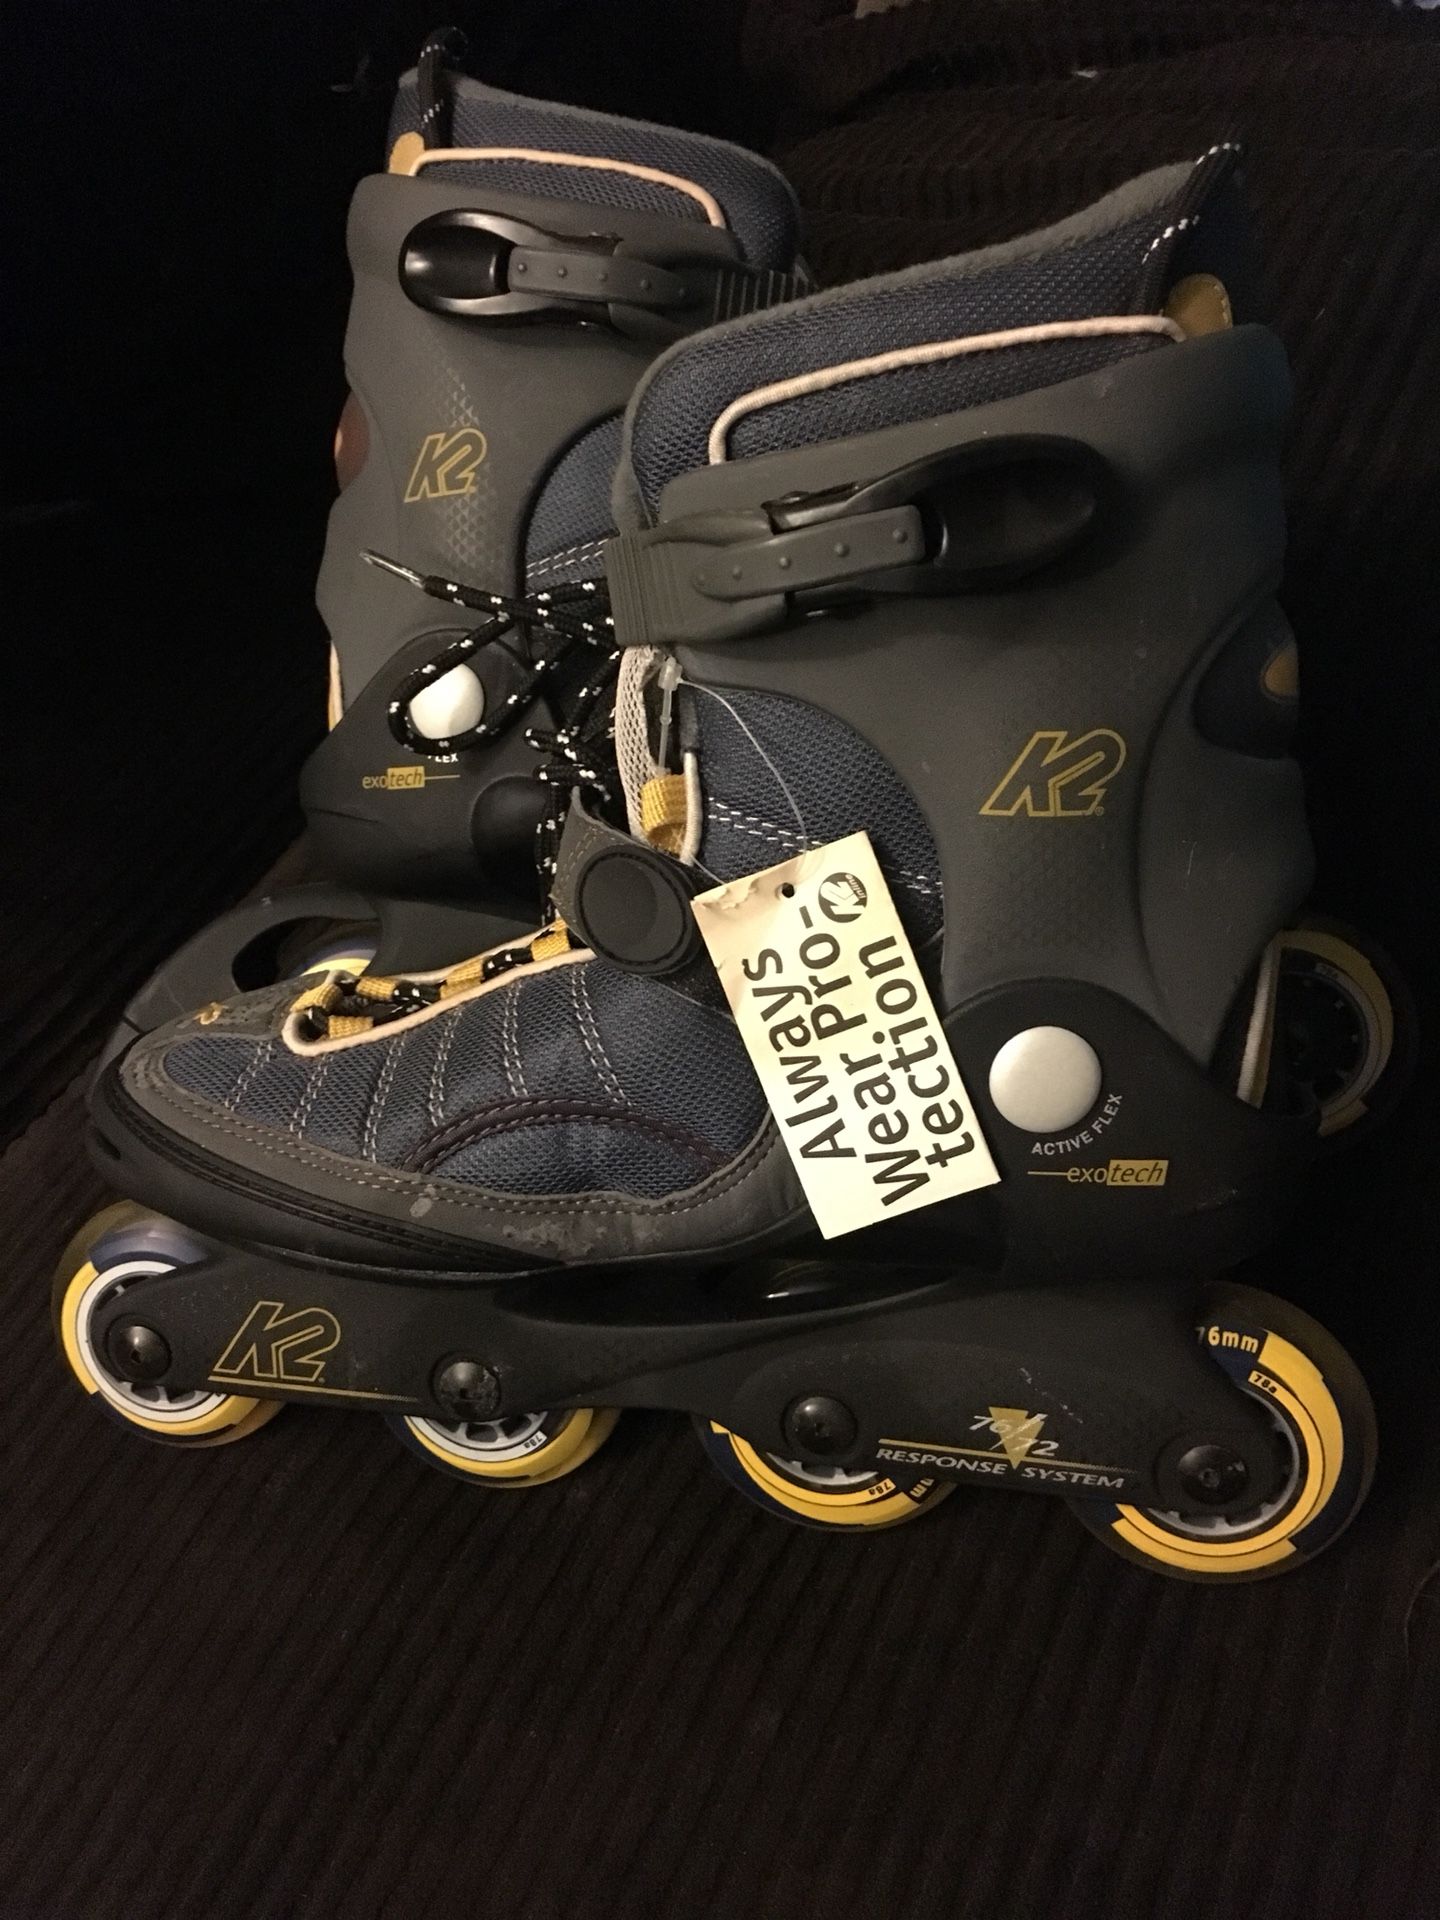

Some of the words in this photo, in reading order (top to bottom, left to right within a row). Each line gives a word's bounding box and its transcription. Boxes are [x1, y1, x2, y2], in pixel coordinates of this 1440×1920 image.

[404, 428, 487, 502] K2
[362, 767, 425, 790] exotech
[427, 753, 459, 763] LEX
[979, 728, 1126, 817] K2
[799, 905, 867, 1040] Pro-
[742, 948, 857, 1158] Always
[858, 935, 976, 1168] tection
[840, 1053, 930, 1206] Wear
[1031, 1130, 1094, 1156] ACTIVE
[1091, 1093, 1123, 1134] FLEX
[1066, 1160, 1169, 1186] exotech
[212, 1300, 341, 1383] K2
[876, 1448, 1008, 1475] RESPONSE
[1021, 1466, 1126, 1489] SYSTEM
